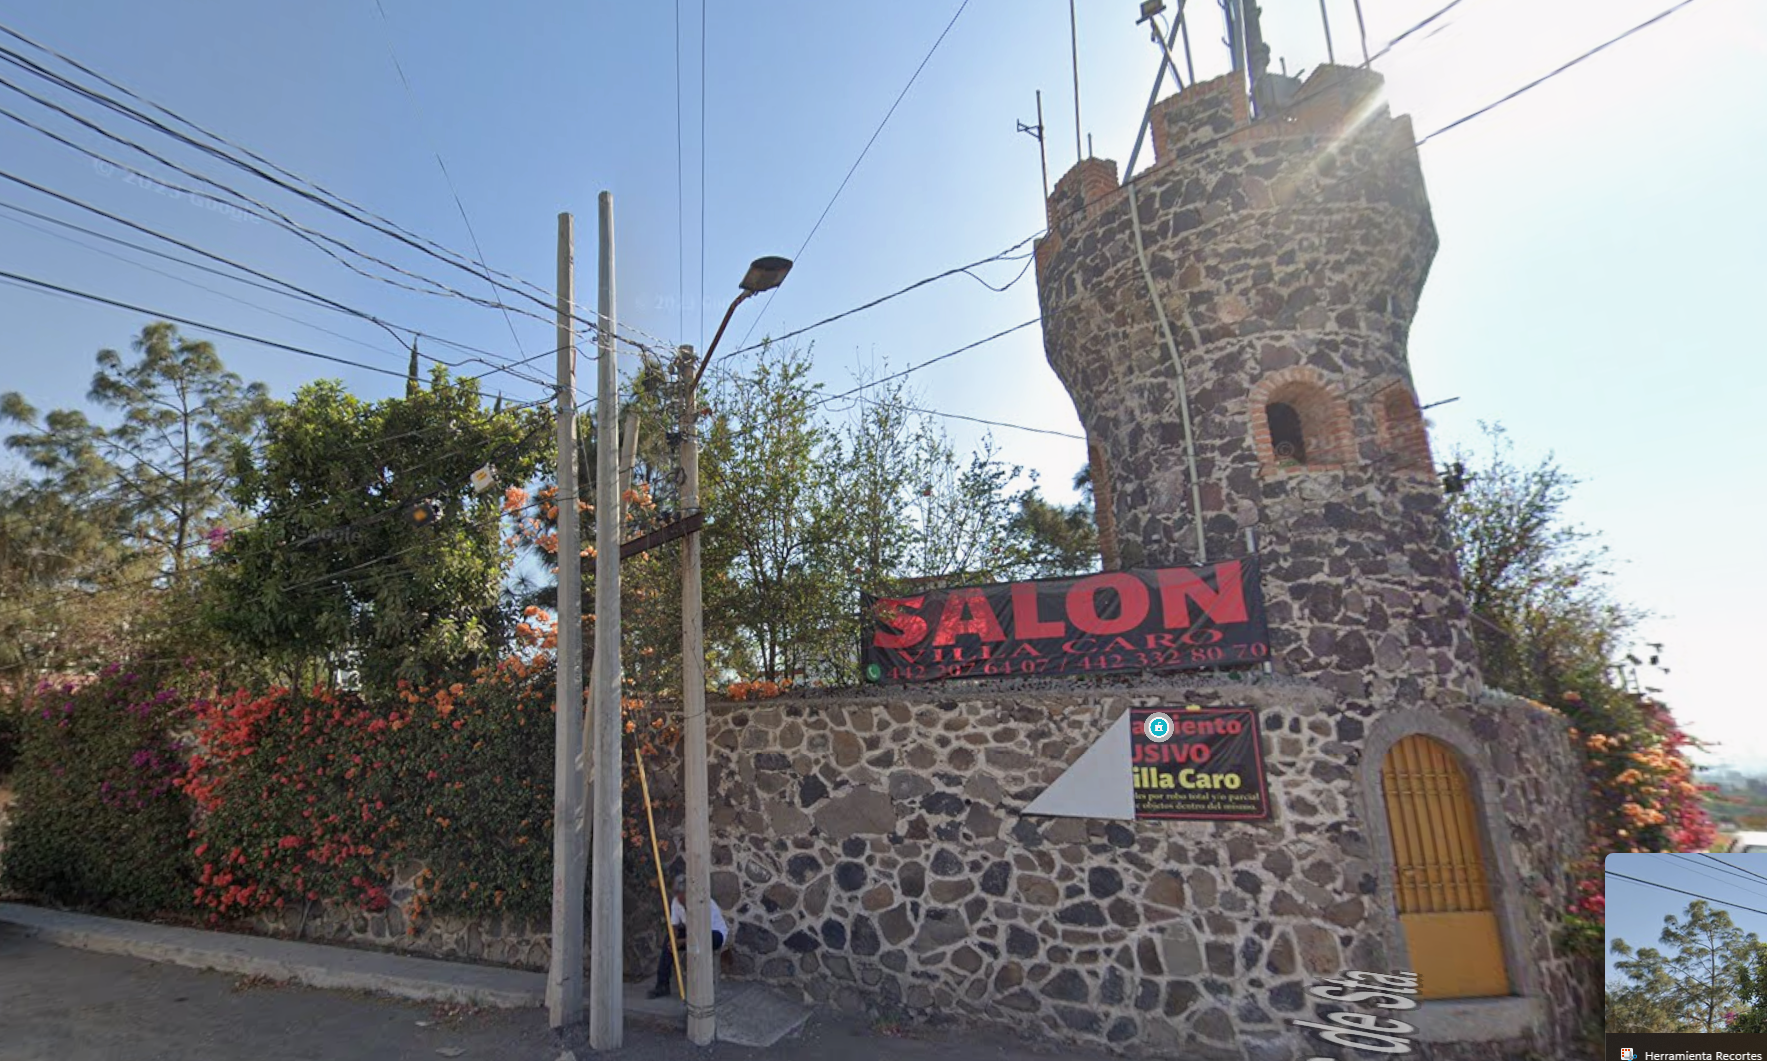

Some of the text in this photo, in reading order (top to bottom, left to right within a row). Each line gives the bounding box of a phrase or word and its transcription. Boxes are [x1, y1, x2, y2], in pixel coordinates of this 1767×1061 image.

[873, 559, 1249, 649] SALON
[1062, 629, 1223, 655] CARO
[887, 665, 927, 680] 442
[983, 659, 1012, 675] 64
[1020, 658, 1049, 673] 07
[1078, 653, 1125, 670] 442
[1135, 650, 1183, 668] 332
[1191, 646, 1224, 662] 80
[1232, 642, 1268, 657] 70
[1178, 768, 1242, 789] Caro
